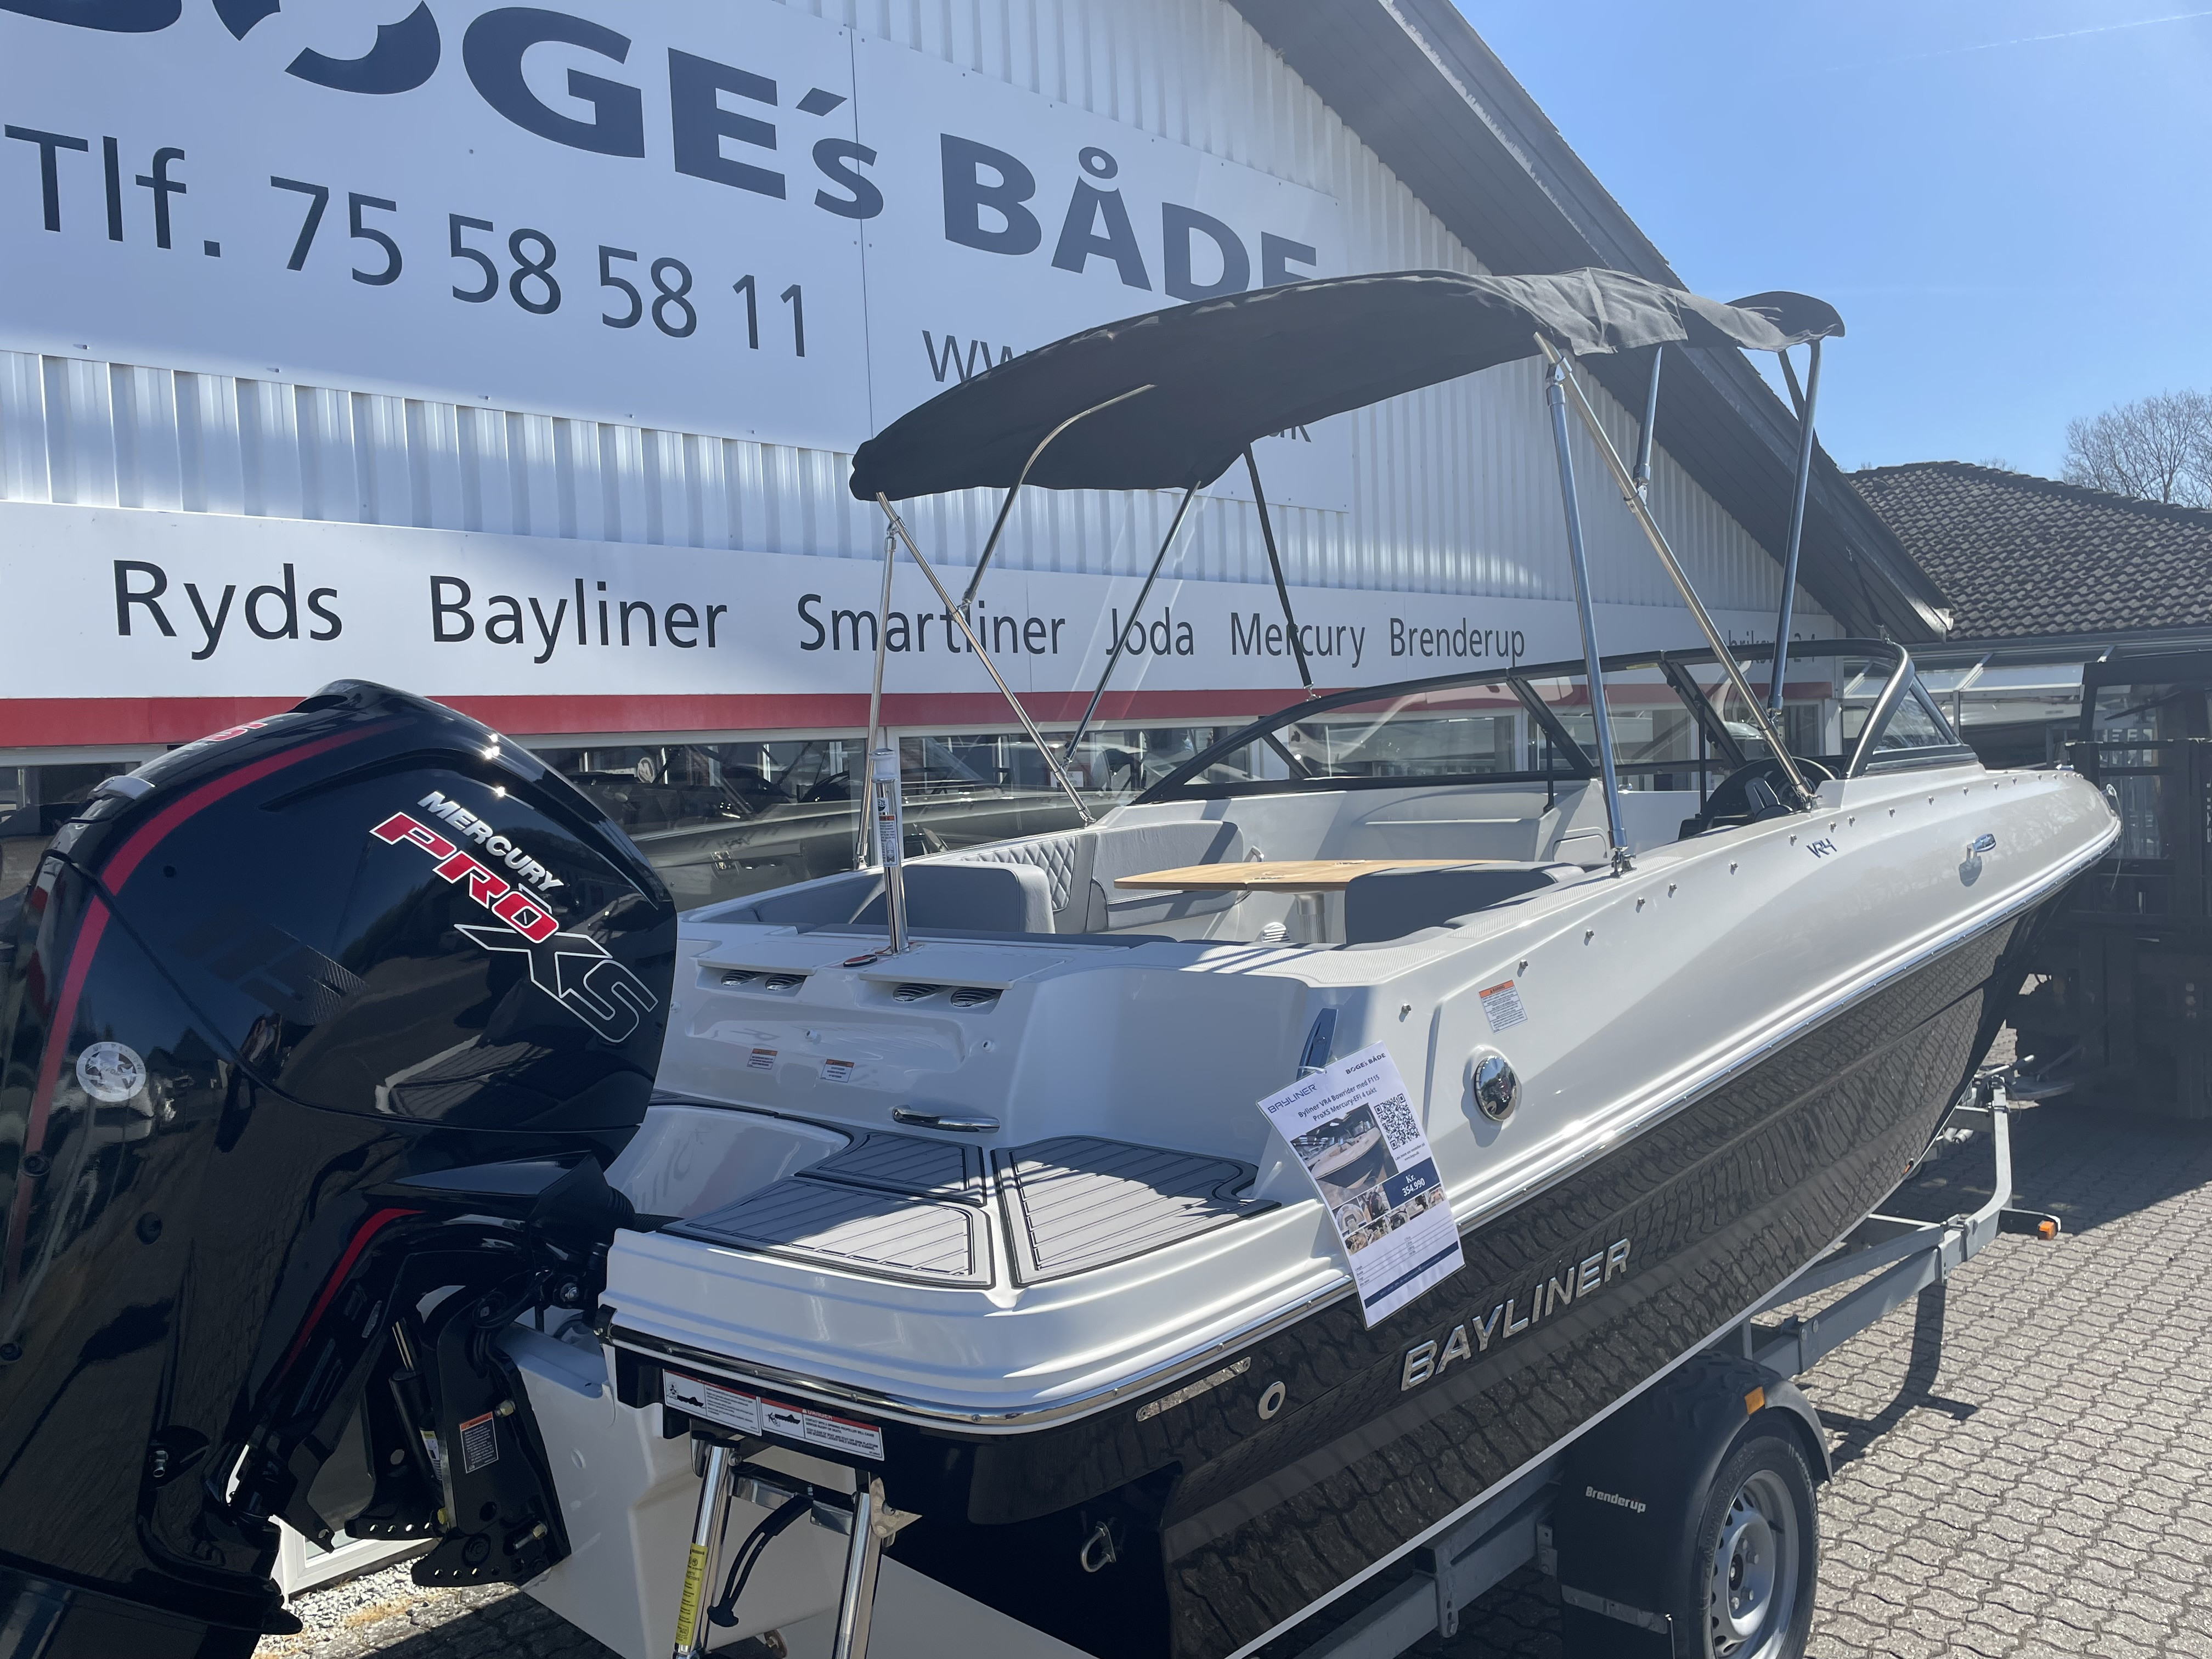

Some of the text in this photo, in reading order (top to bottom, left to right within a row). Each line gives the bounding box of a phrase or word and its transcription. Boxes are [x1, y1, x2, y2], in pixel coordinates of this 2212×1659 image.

[4, 124, 221, 258] Tlf.
[270, 175, 403, 286] 75
[449, 213, 561, 315] 58
[598, 245, 697, 338] 58
[732, 274, 805, 358] 11
[940, 133, 1317, 303] BÅDE
[114, 560, 1525, 668] Ryds Bayliner Smartliner Joda Mercury Brenderup
[417, 791, 565, 892] MERCURY
[1806, 838, 1837, 858] VR4
[369, 811, 559, 944] PRO
[454, 883, 658, 1043] XS
[1319, 1097, 1331, 1107] VR4
[1331, 1086, 1356, 1101] Bowrider
[1356, 1079, 1368, 1090] med
[1368, 1074, 1380, 1084] F115
[1368, 1053, 1386, 1064] BÅDE
[1267, 1083, 1317, 1114] BAYLINER
[1313, 1109, 1331, 1121] ProXS
[1366, 1087, 1378, 1096] takt
[1406, 1173, 1416, 1184] Kr.
[1401, 1238, 1631, 1391] BAYLINER
[1585, 1486, 1646, 1513] Brenderup
